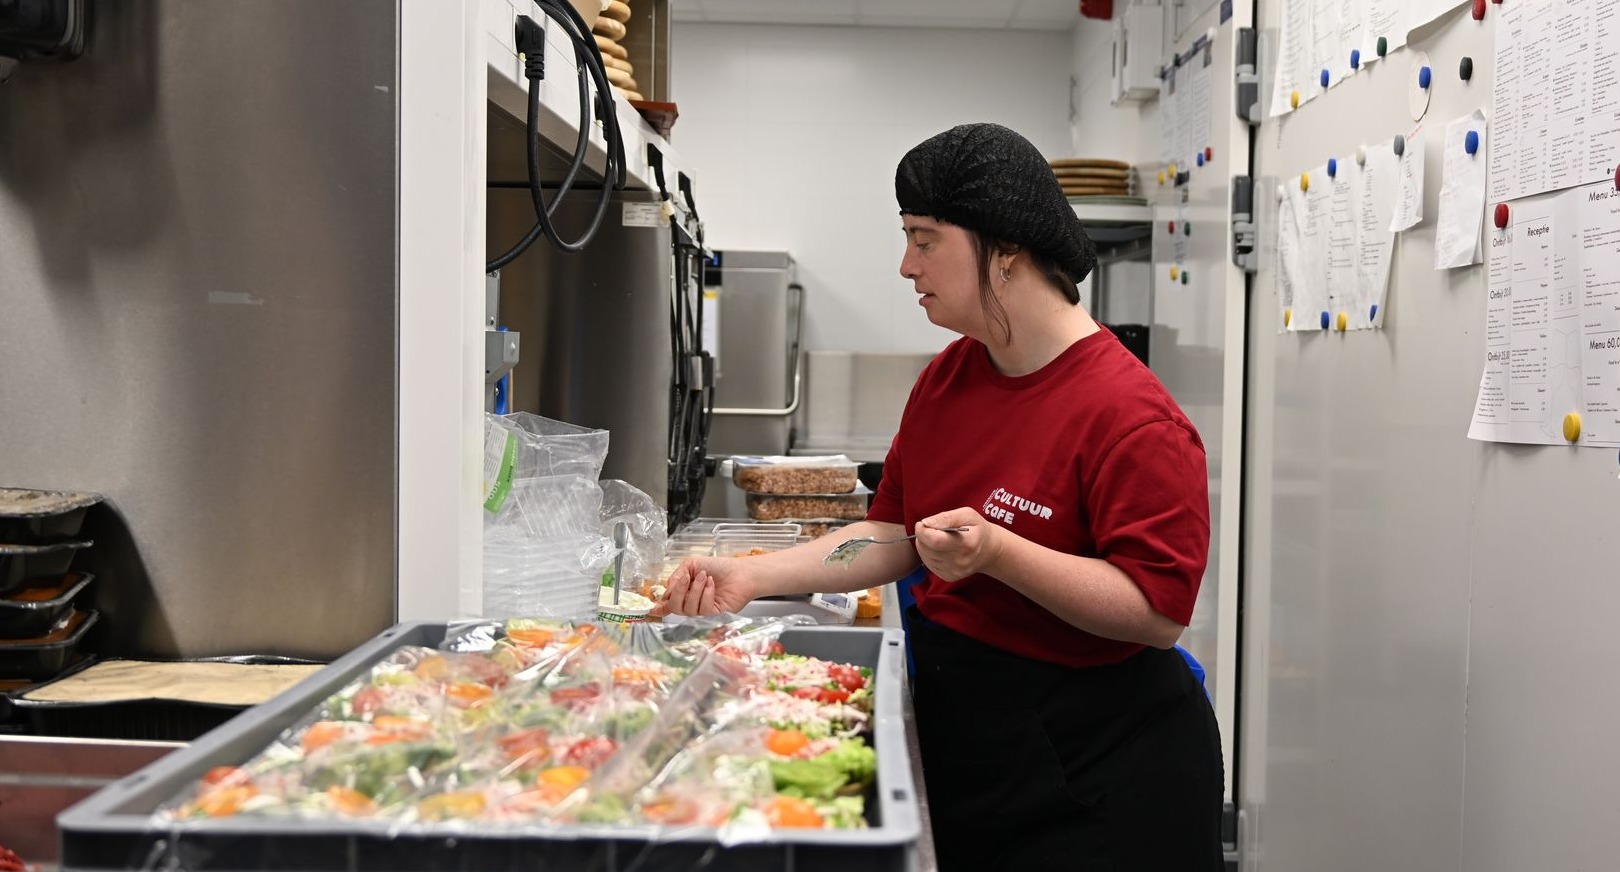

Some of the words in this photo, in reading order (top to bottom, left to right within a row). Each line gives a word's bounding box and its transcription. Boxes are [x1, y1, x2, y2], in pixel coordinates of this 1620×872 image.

[1588, 191, 1608, 202] Menu
[1527, 224, 1549, 237] Receptie
[1589, 340, 1606, 349] Menu
[994, 487, 1053, 520] CULTUUR
